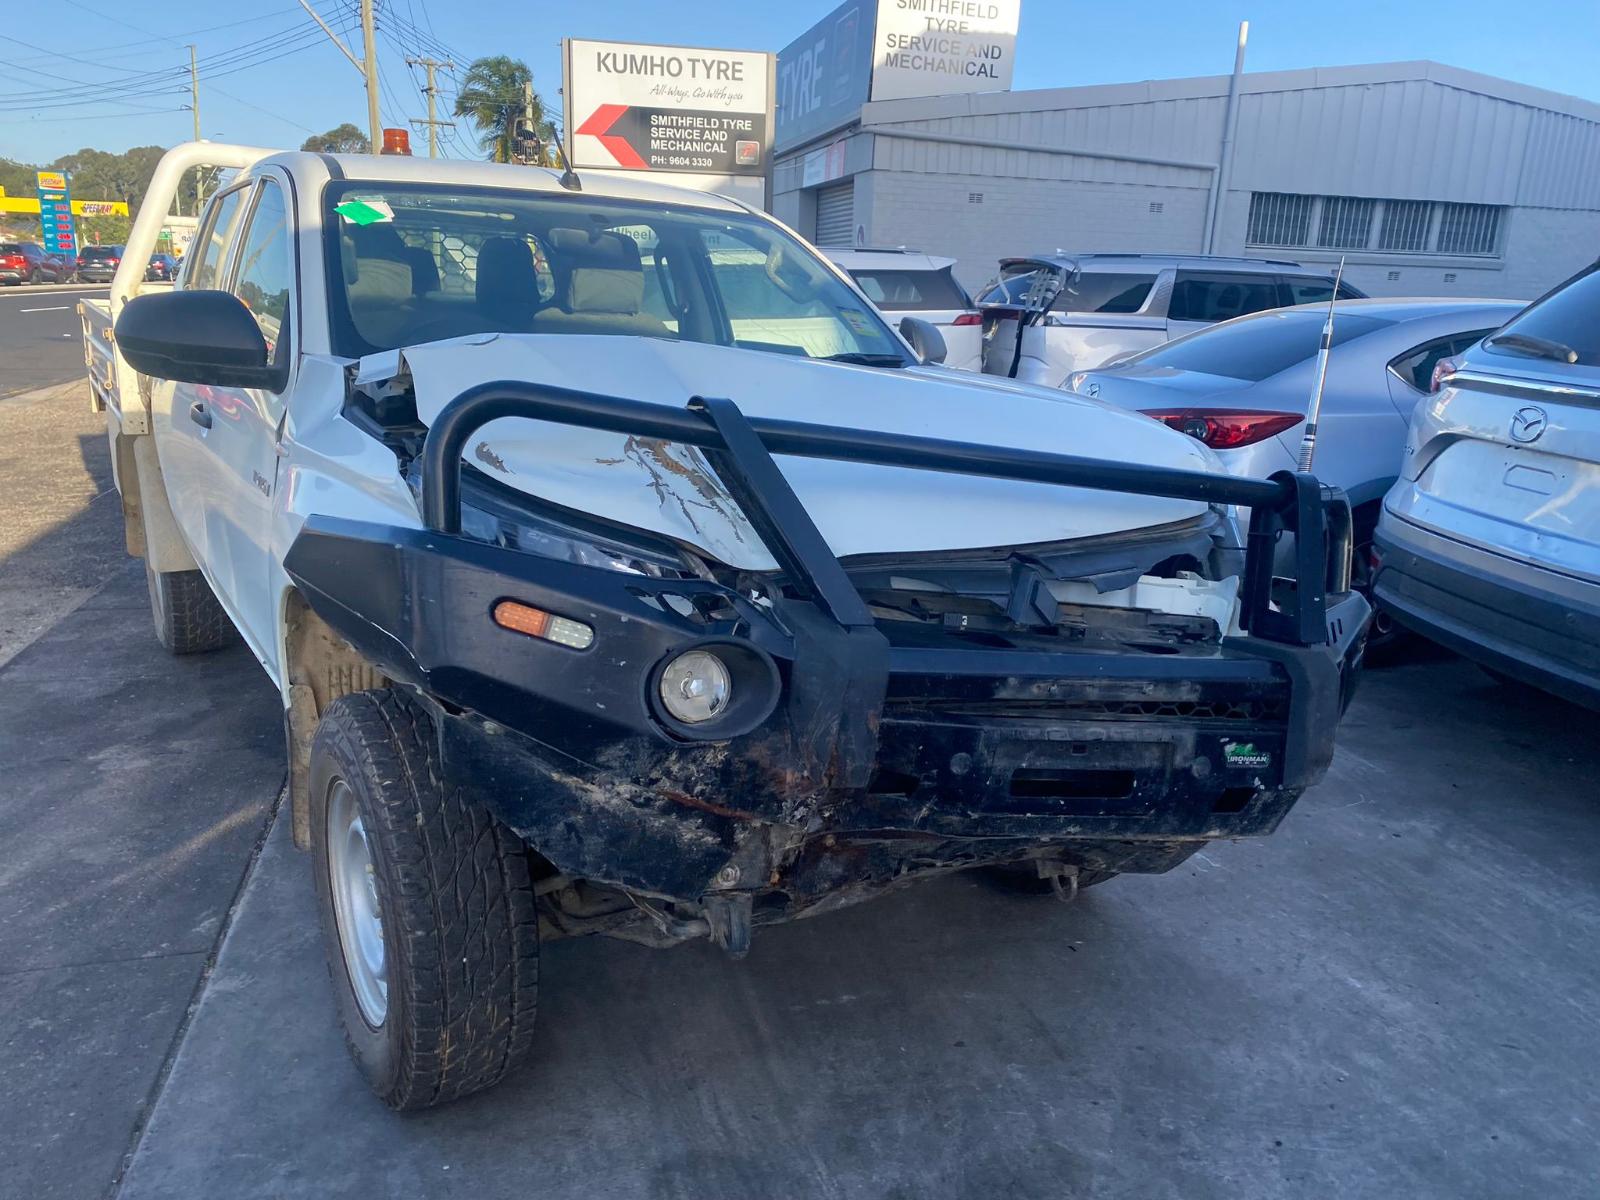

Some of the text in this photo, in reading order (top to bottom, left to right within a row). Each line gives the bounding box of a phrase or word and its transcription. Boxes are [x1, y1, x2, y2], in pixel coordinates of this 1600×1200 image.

[896, 0, 999, 20] SMITHFIELD
[924, 16, 969, 35] TYRE
[886, 33, 1002, 60] SERVICE AND
[597, 51, 744, 81] KUMHO TYRE
[885, 52, 999, 78] MECHANICAL
[782, 37, 826, 126] TYRE
[692, 87, 706, 99] Go
[727, 94, 744, 106] you
[650, 114, 752, 130] SMITHFIELD TYRE
[650, 127, 728, 141] SERVICE AND
[650, 139, 727, 153] MECHANICAL
[651, 155, 713, 167] PH: 9604 3330
[961, 615, 968, 626] 3
